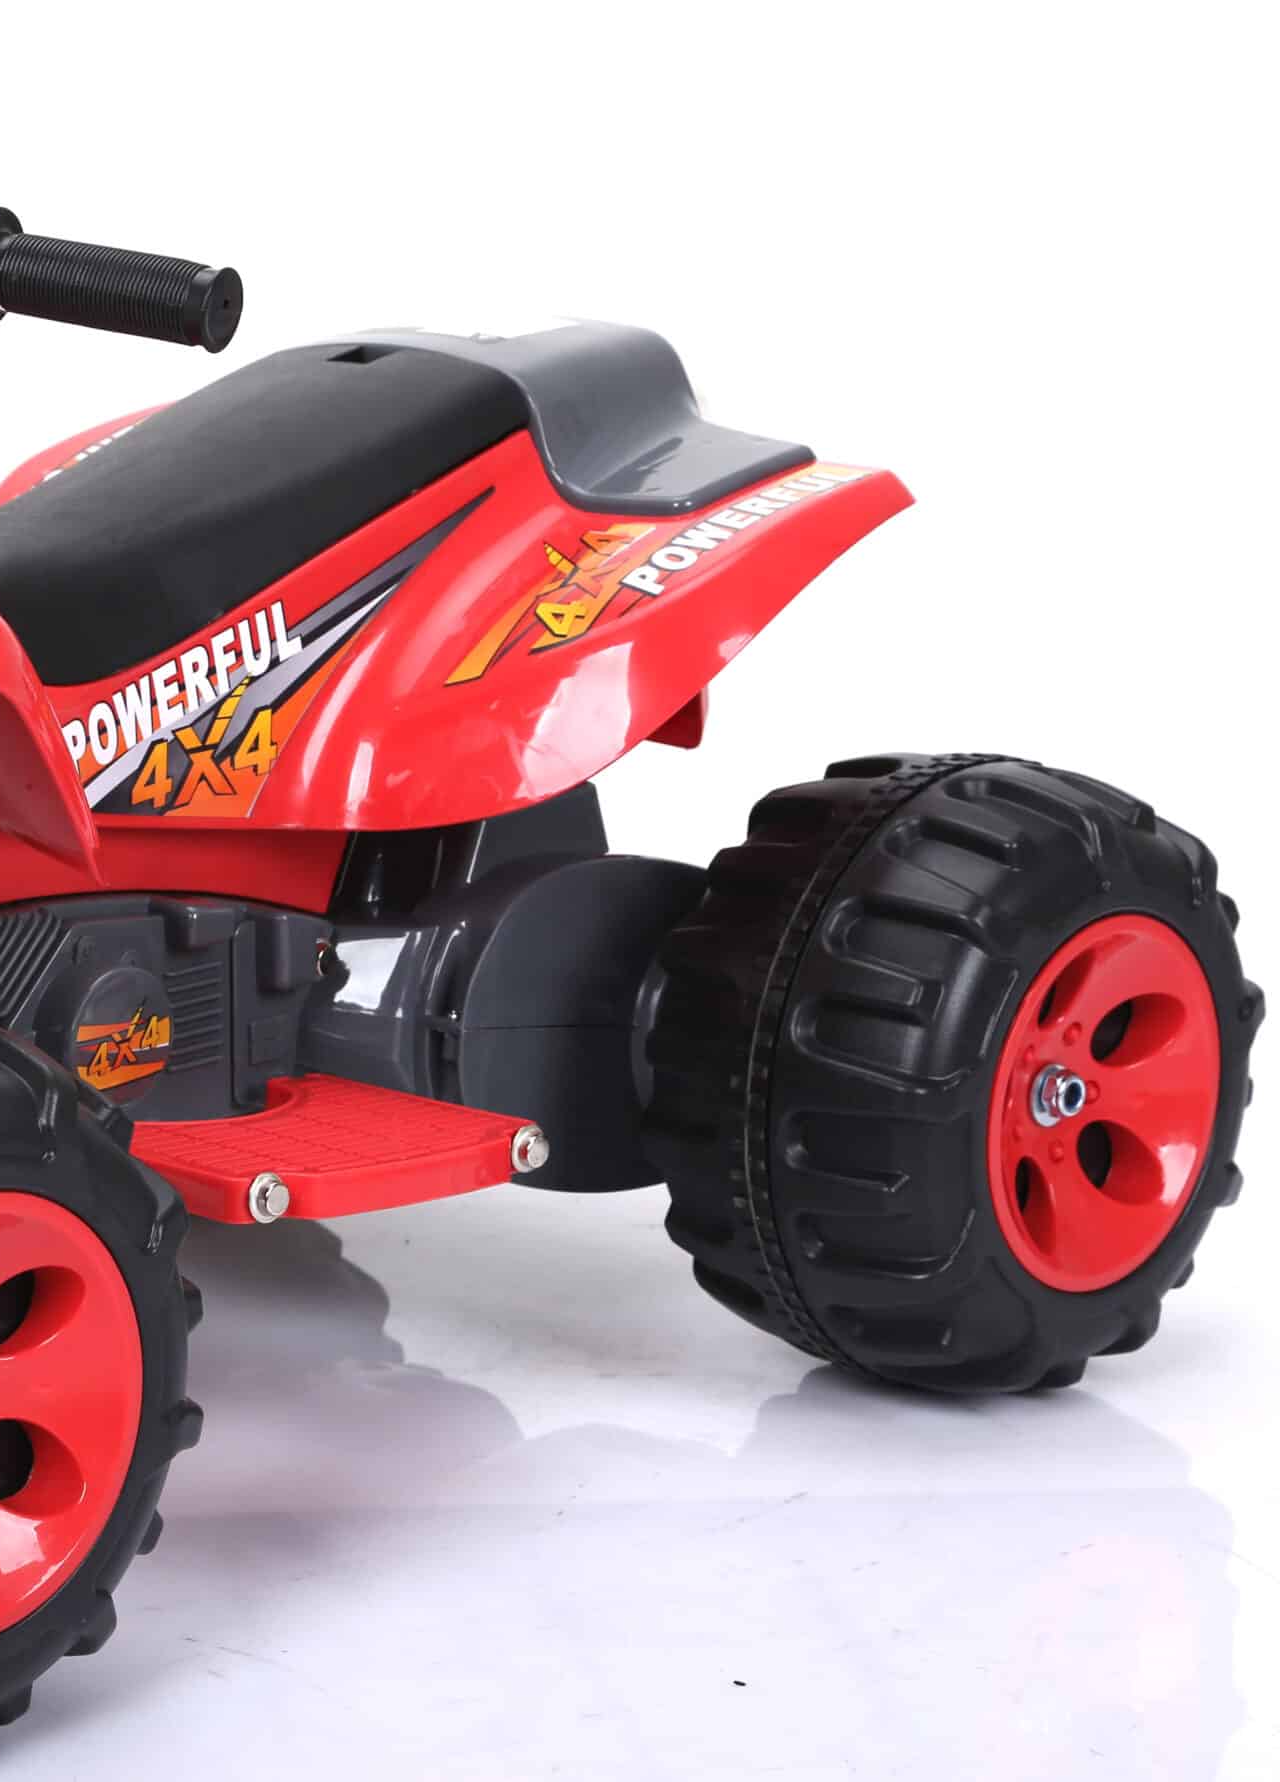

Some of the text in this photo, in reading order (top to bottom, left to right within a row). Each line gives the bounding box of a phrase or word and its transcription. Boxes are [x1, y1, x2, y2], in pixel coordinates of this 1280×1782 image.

[535, 523, 640, 637] 4X4
[621, 469, 862, 596] POWERFUL
[61, 600, 303, 774] POWERFUL
[130, 676, 278, 809] 4X4
[87, 1007, 160, 1077] 4X4
